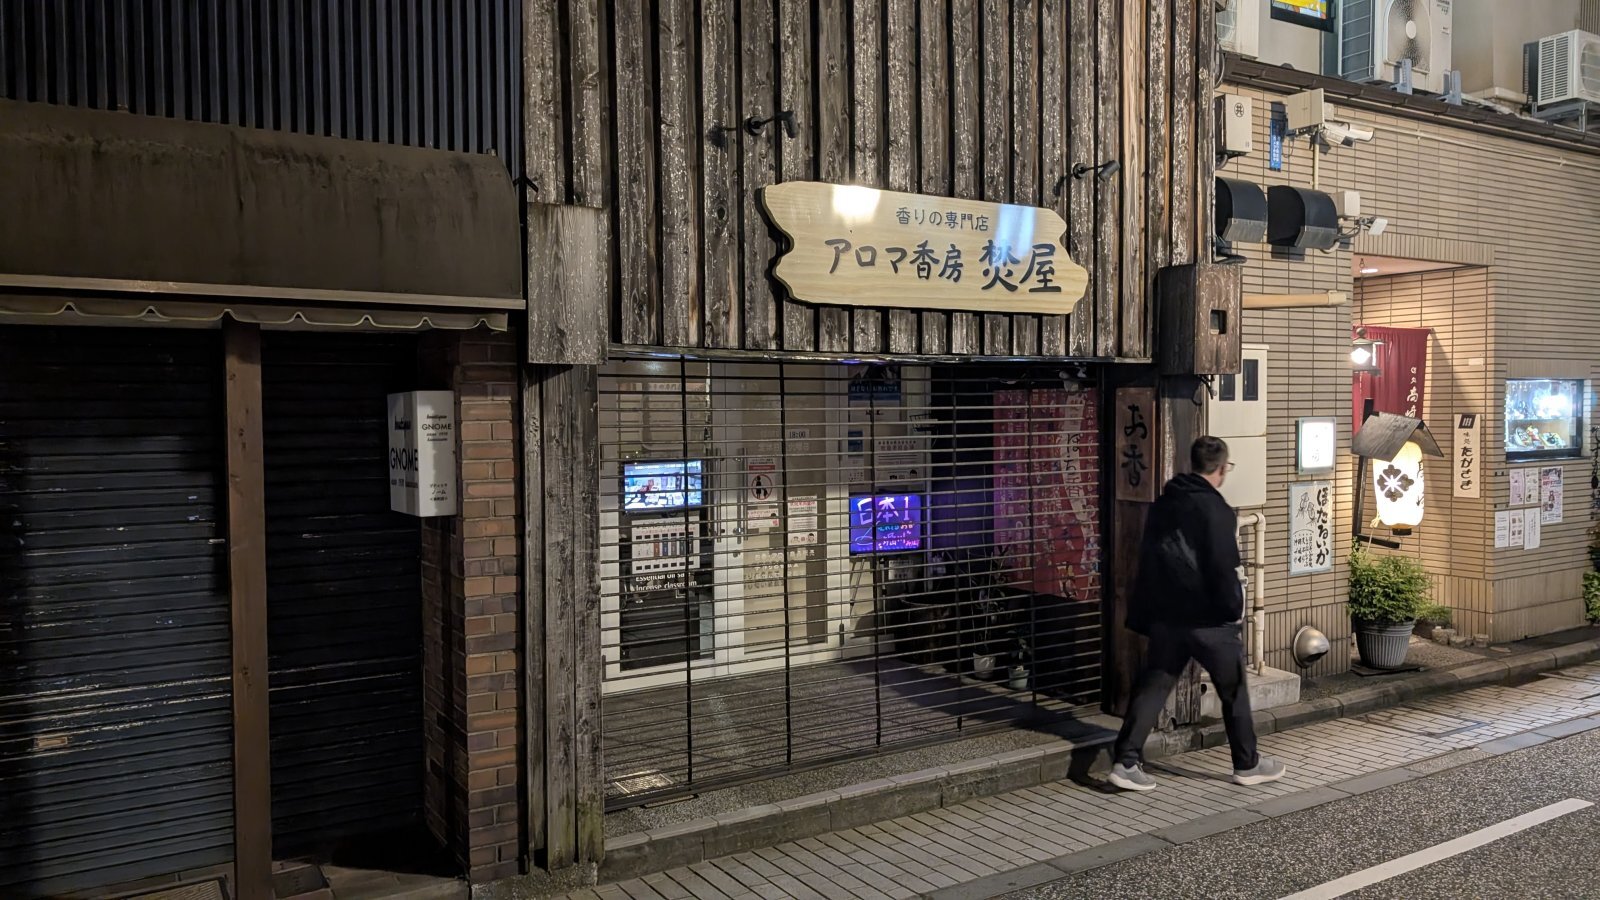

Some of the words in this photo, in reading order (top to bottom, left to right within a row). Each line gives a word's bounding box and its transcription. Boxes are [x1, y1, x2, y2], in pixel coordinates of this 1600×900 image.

[895, 207, 989, 231] 香りの専門店
[824, 239, 964, 283] アロマ香房
[978, 239, 1062, 293] 焚屋
[422, 423, 452, 431] GNOME
[789, 431, 806, 439] 18:00
[390, 448, 418, 471] GNOME
[1121, 404, 1148, 487] お香
[1460, 446, 1473, 490] たかさき
[1315, 487, 1329, 566] ほたるいか
